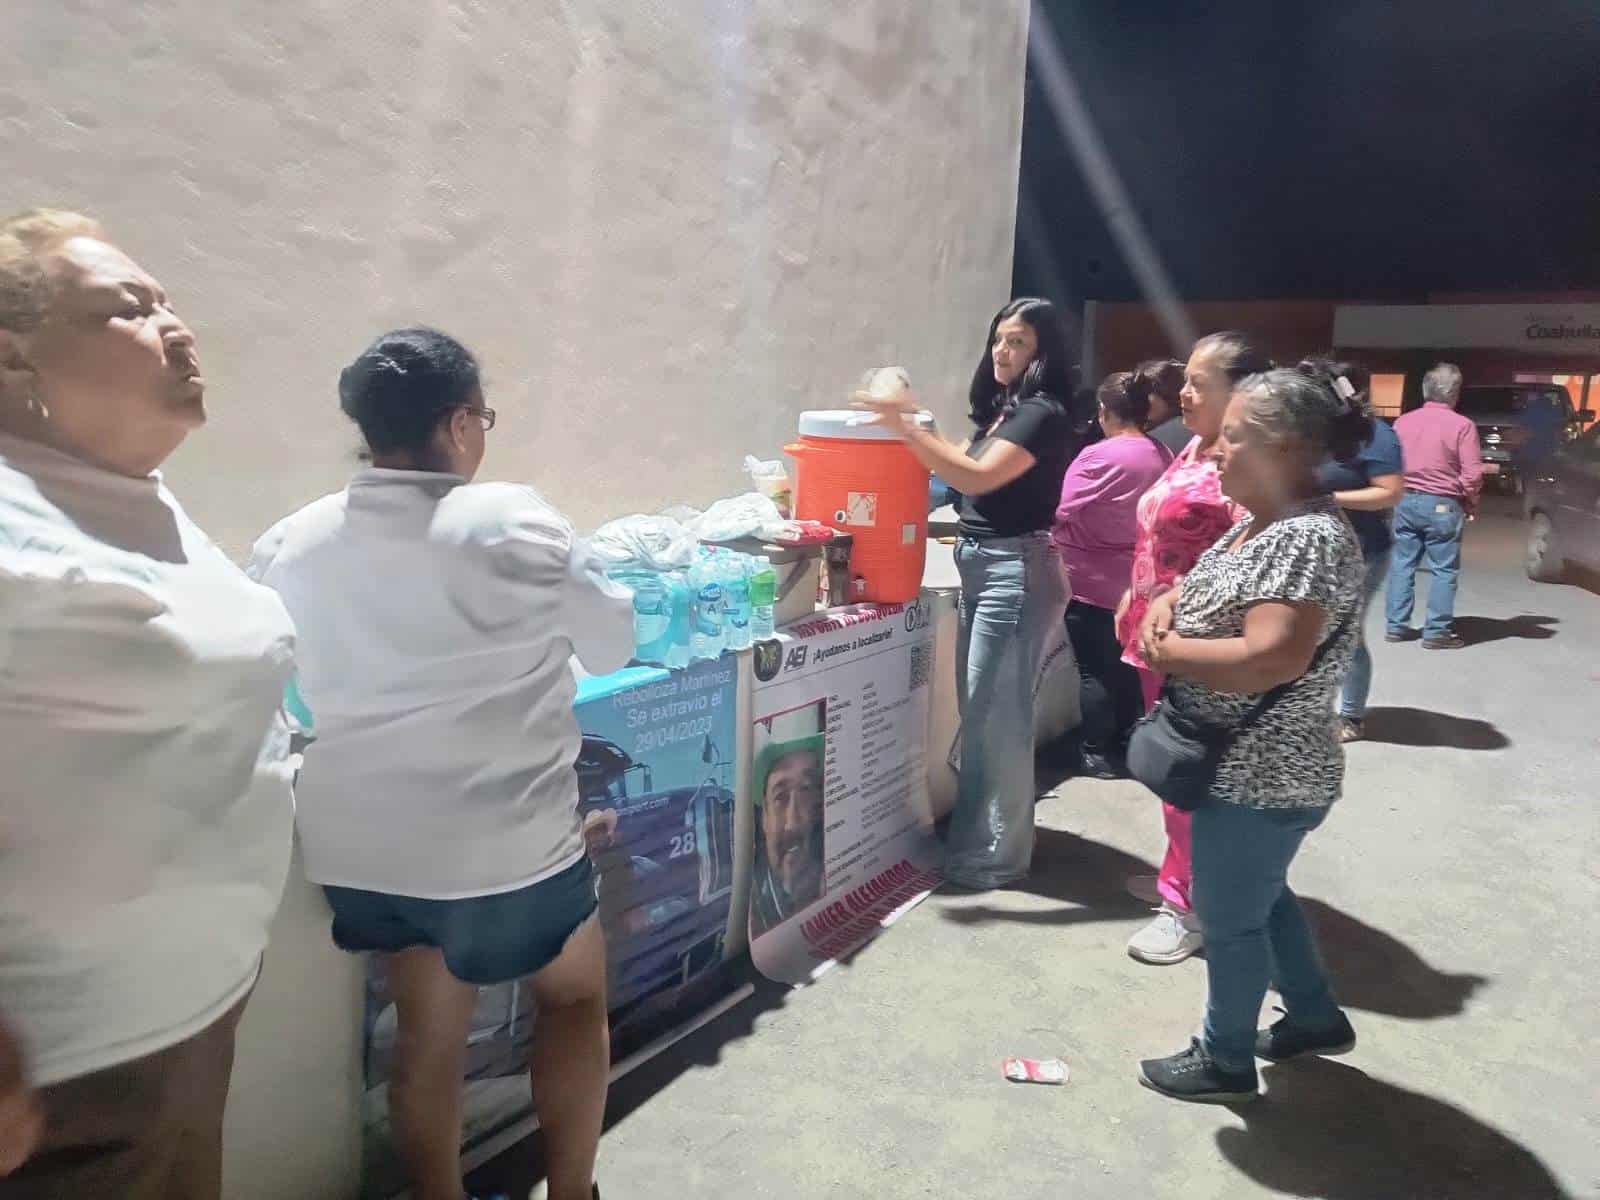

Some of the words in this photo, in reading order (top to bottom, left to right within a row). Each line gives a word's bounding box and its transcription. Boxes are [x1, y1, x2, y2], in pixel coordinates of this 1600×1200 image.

[784, 645, 808, 670] AEI
[627, 708, 648, 728] Se
[634, 715, 713, 752] 29/04/2023
[669, 831, 696, 860] 28
